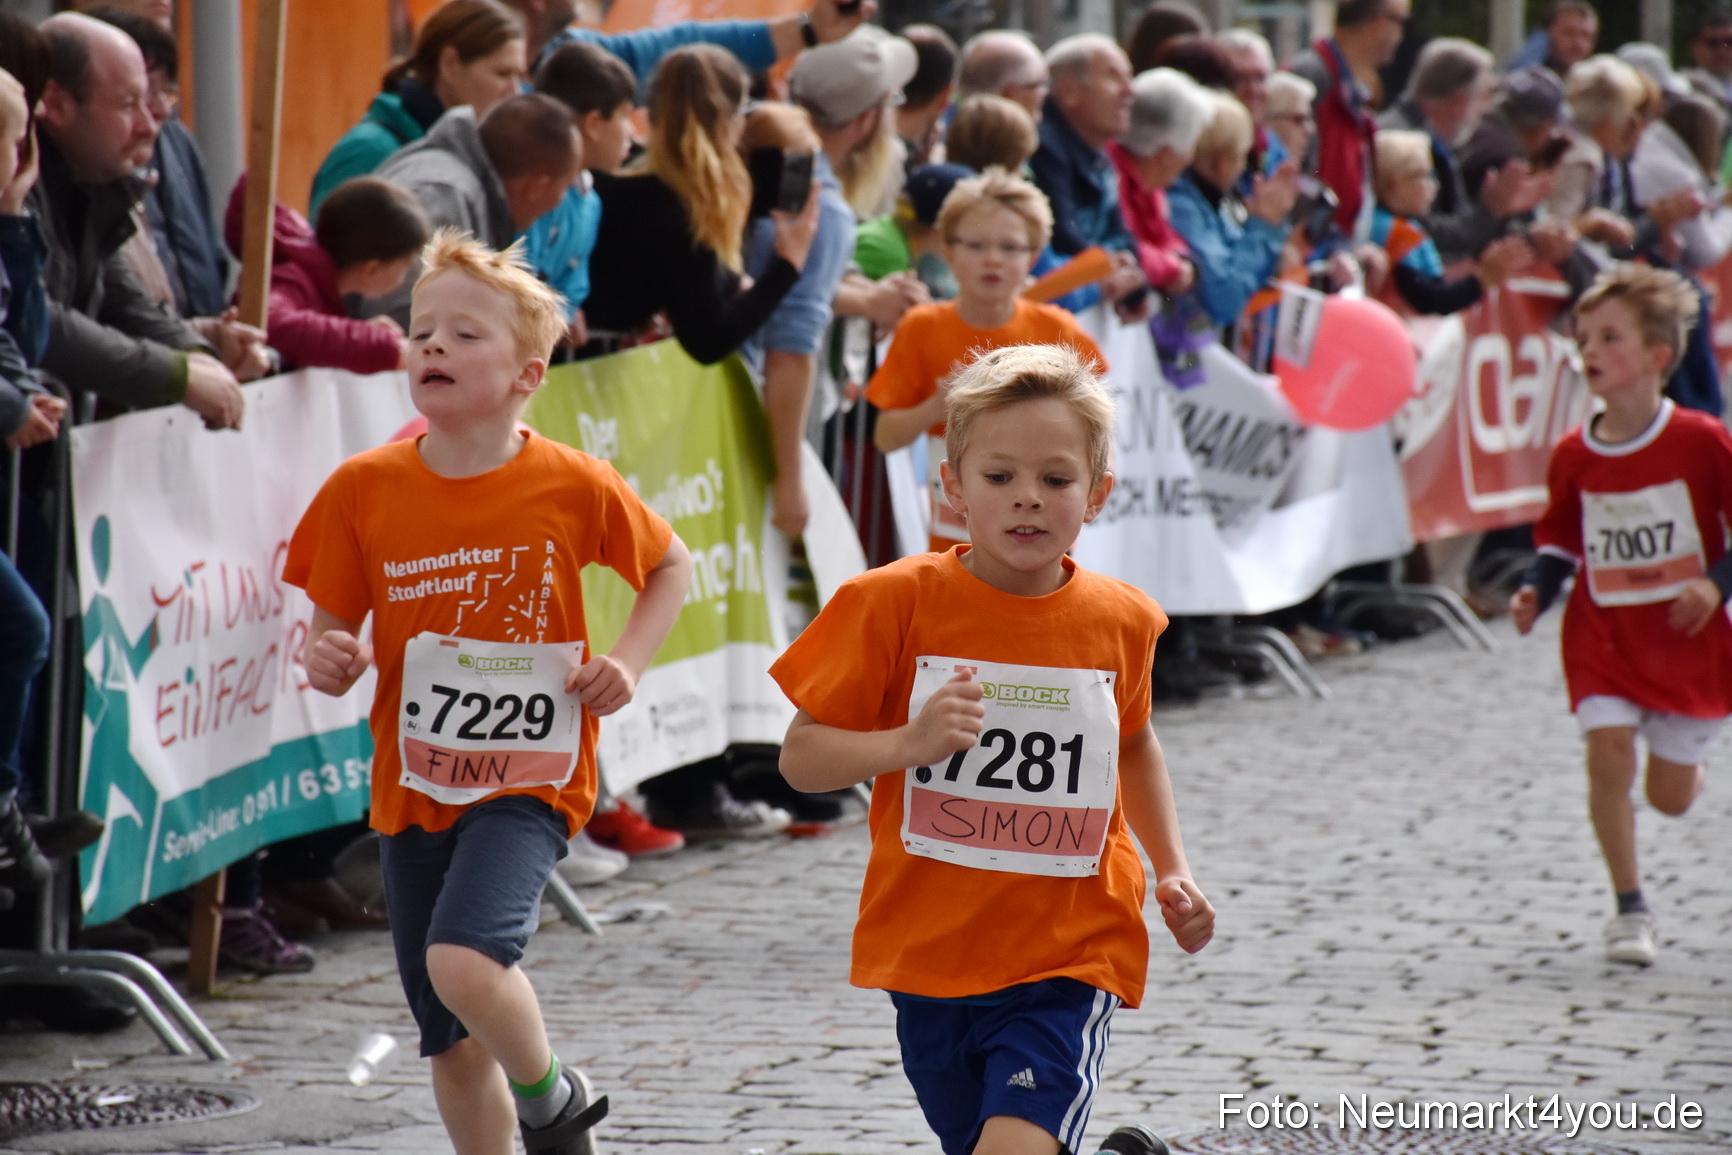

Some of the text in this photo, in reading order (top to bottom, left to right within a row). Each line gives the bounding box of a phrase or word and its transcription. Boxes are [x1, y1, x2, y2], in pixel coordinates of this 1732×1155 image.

[1599, 521, 1674, 561] 7007
[384, 547, 502, 578] Neumarkter
[387, 571, 477, 602] Stadtlauf
[536, 540, 555, 644] BAMBINI
[475, 656, 534, 671] BOCK
[996, 700, 1020, 709] inspired
[1046, 704, 1070, 712] concepts
[998, 684, 1070, 705] BOCK
[430, 684, 555, 741] 7229
[427, 748, 510, 784] FINN
[931, 798, 1090, 850] SIMON
[1006, 1078, 1037, 1091] adidas
